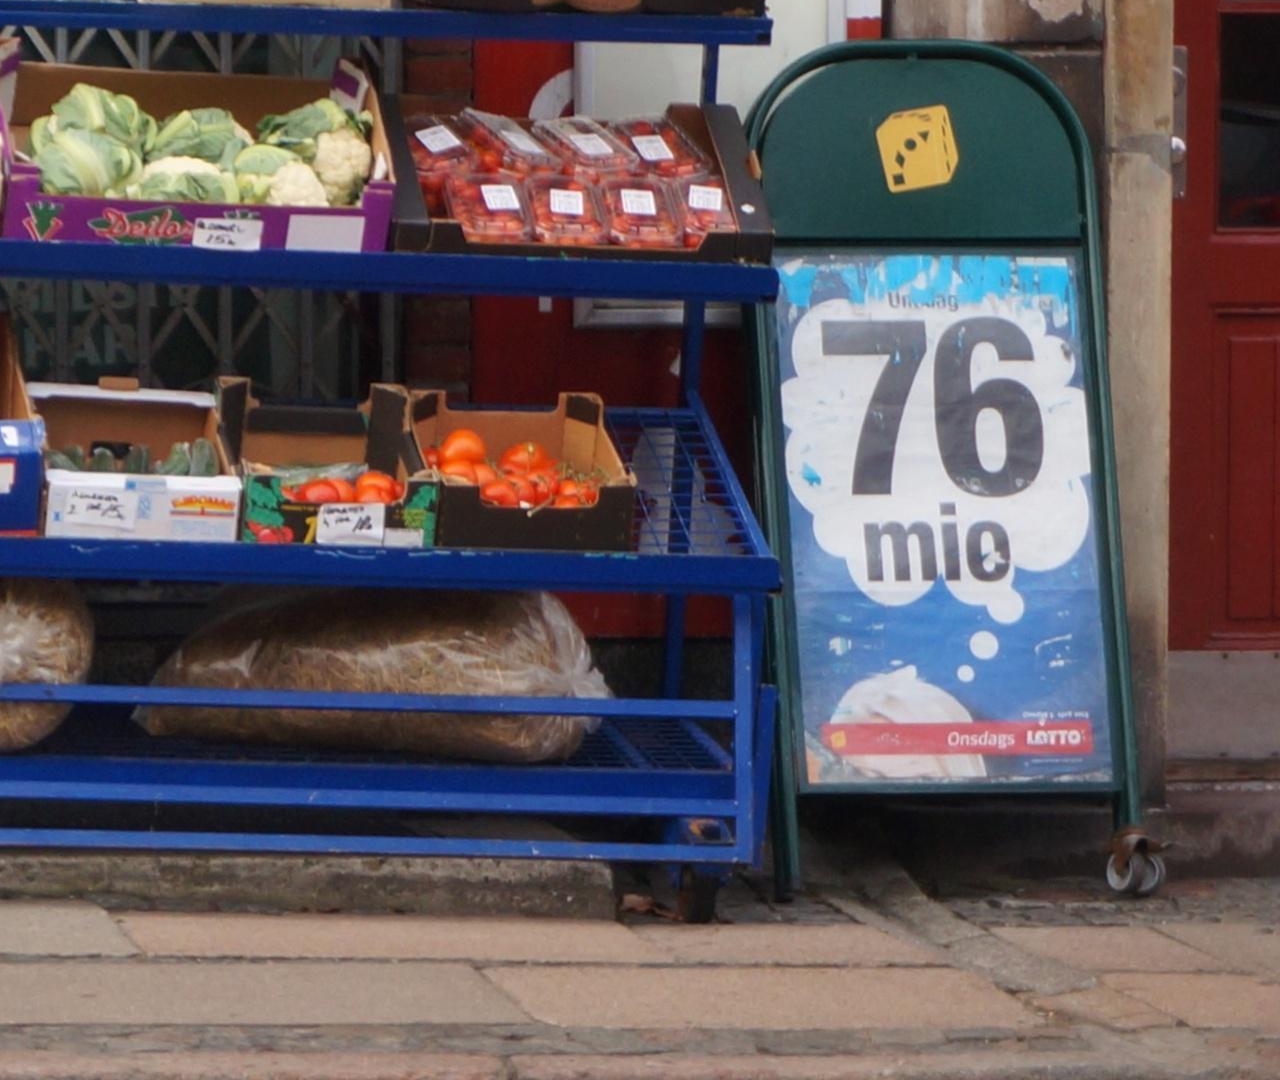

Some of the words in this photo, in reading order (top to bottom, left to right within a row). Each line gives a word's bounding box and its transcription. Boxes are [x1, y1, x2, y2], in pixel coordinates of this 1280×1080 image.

[820, 316, 1044, 498] 76
[863, 503, 1011, 581] mio
[947, 731, 1015, 749] Onsdags
[1027, 729, 1081, 745] LOTTO
